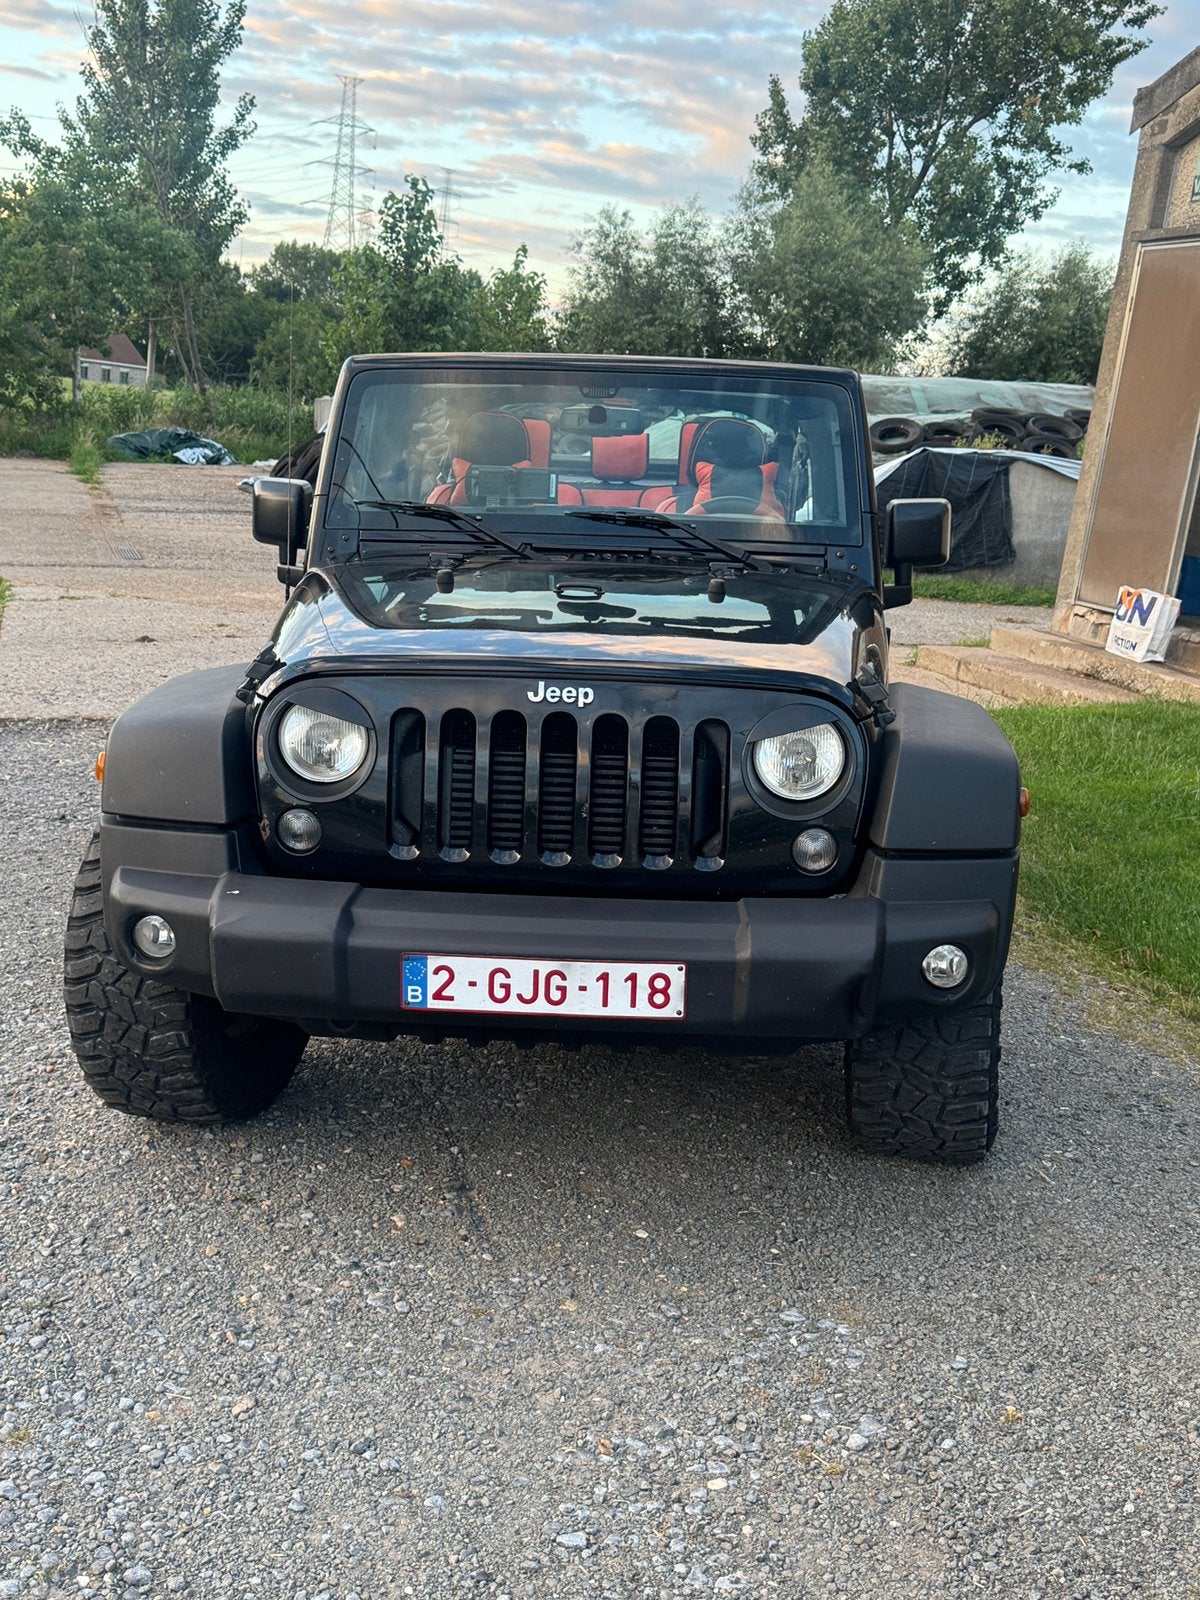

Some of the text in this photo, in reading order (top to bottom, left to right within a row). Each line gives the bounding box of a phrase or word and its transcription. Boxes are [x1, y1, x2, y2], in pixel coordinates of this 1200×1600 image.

[527, 681, 594, 708] Jeep
[407, 985, 422, 1003] B
[432, 965, 672, 1010] 2-GJG-118
